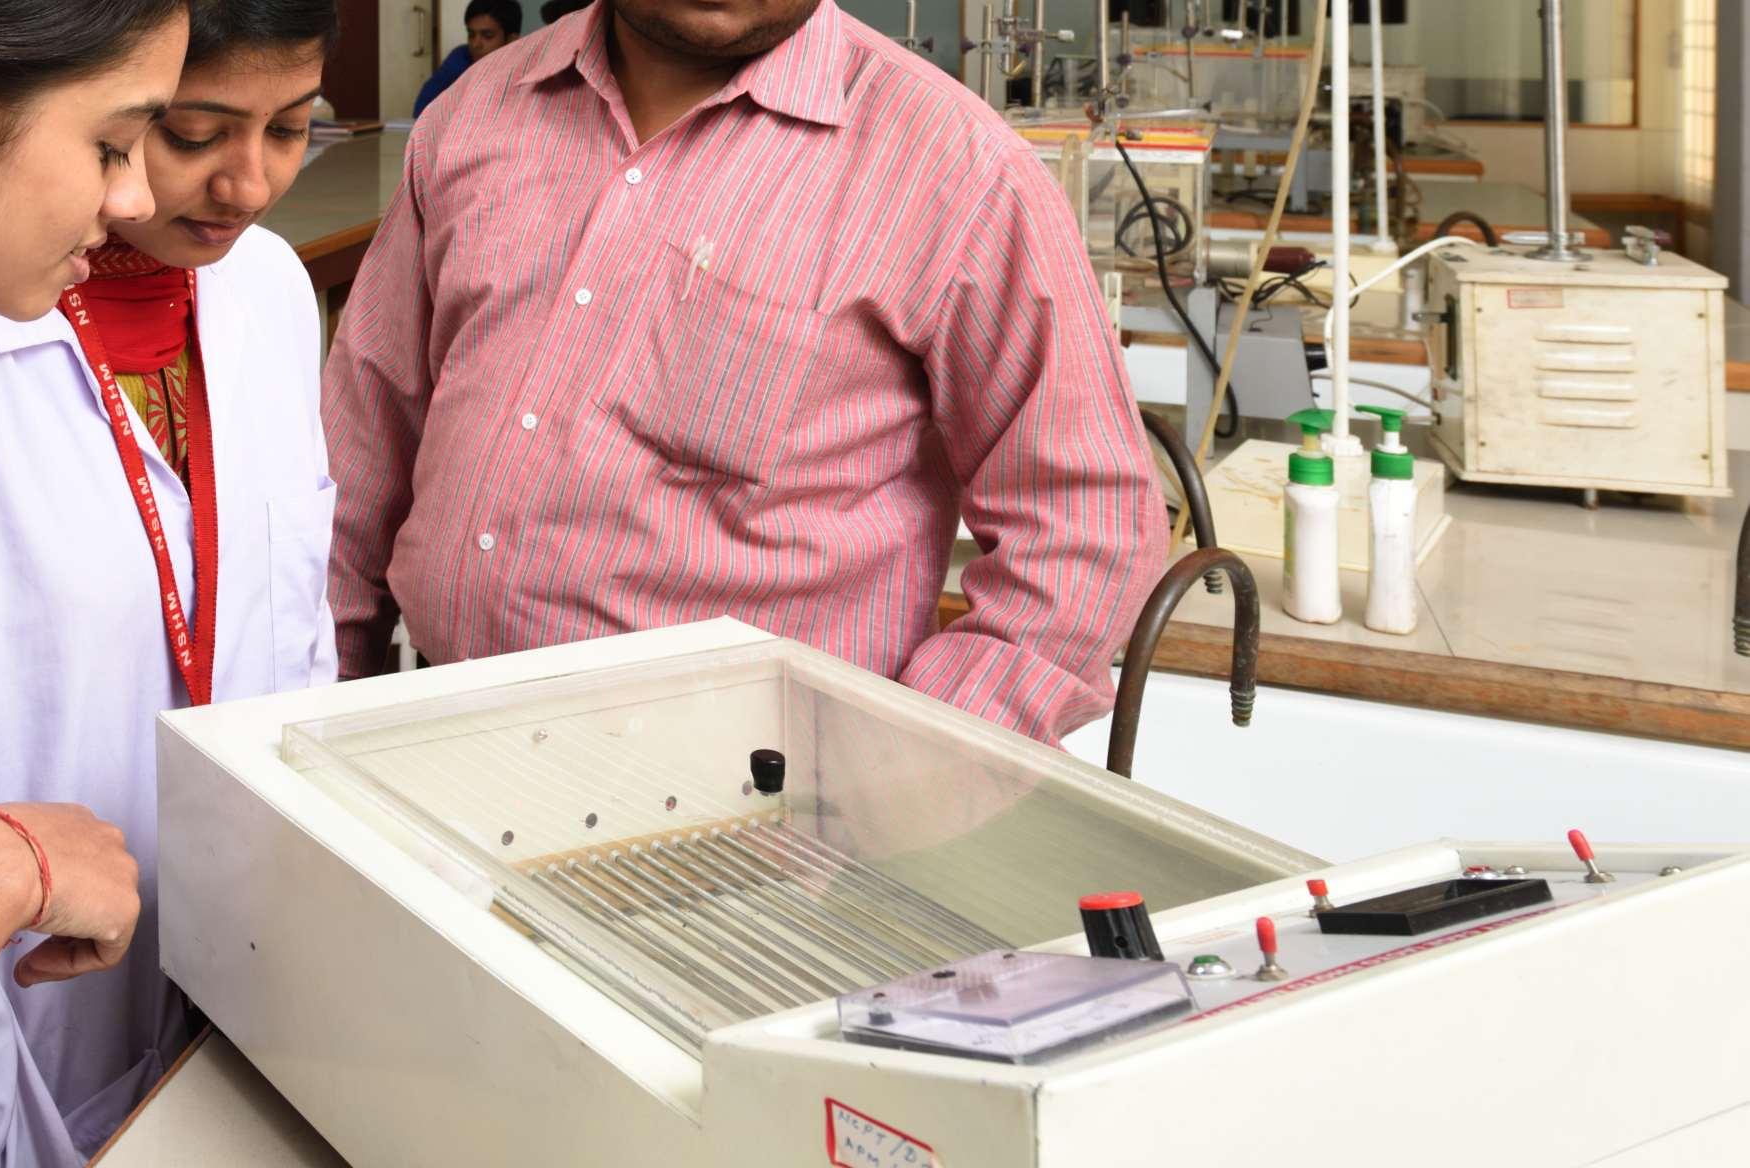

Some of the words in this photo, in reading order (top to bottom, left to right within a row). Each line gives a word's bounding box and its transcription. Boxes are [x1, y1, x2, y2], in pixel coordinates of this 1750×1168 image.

[98, 363, 132, 437] NSHM
[136, 477, 164, 551] NSHM
[166, 592, 192, 668] NSHM
